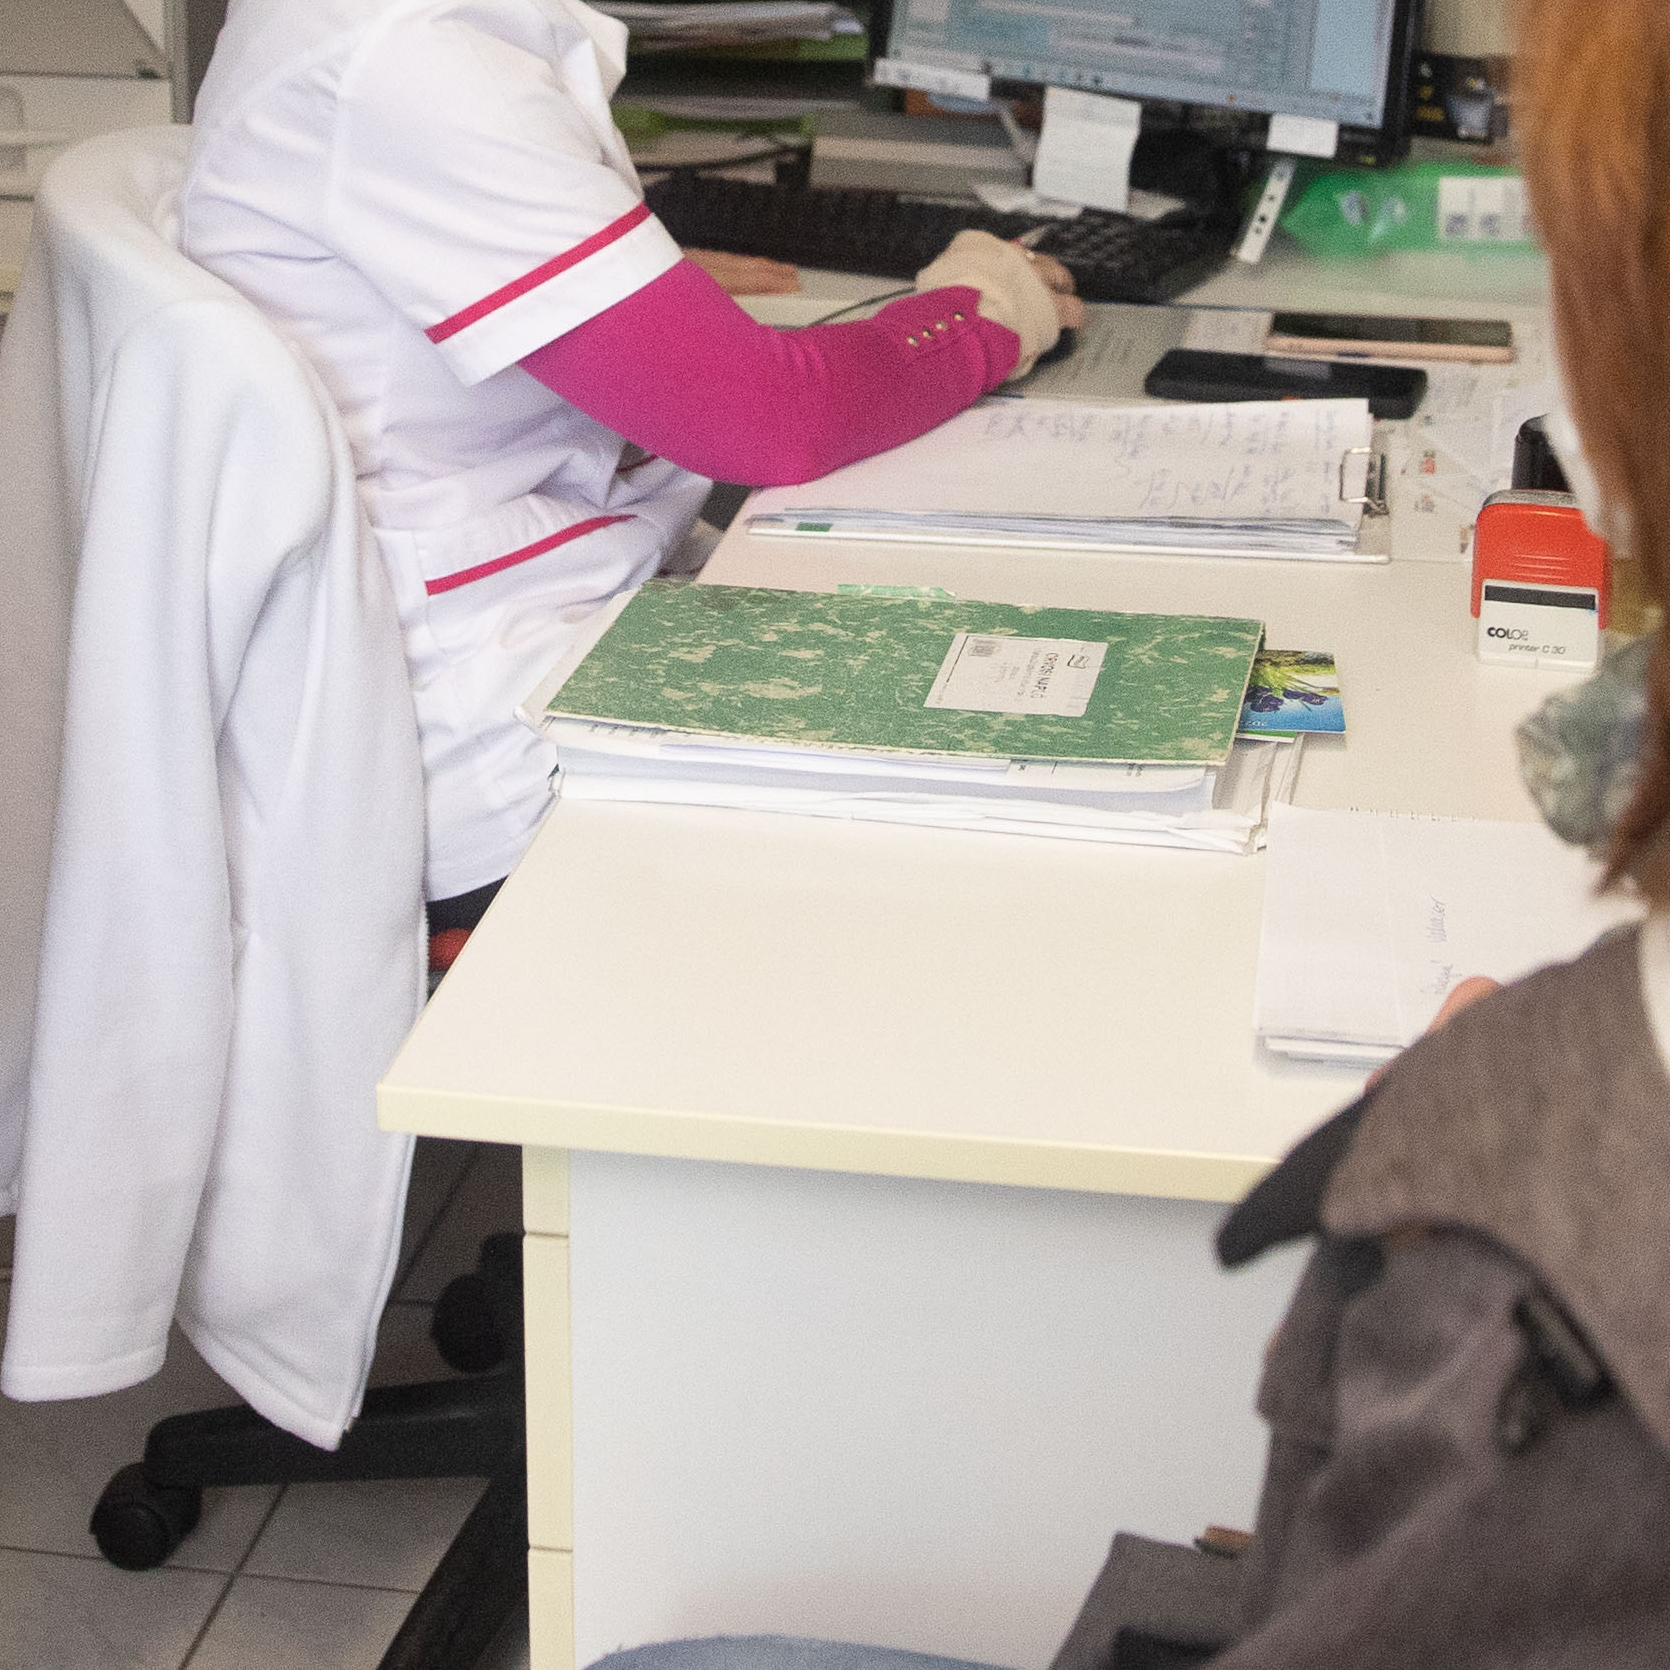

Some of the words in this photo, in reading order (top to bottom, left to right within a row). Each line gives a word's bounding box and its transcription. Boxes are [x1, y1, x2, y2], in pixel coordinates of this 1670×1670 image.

[1508, 643, 1539, 653] printer
[1541, 644, 1550, 654] C
[1551, 645, 1567, 655] 30
